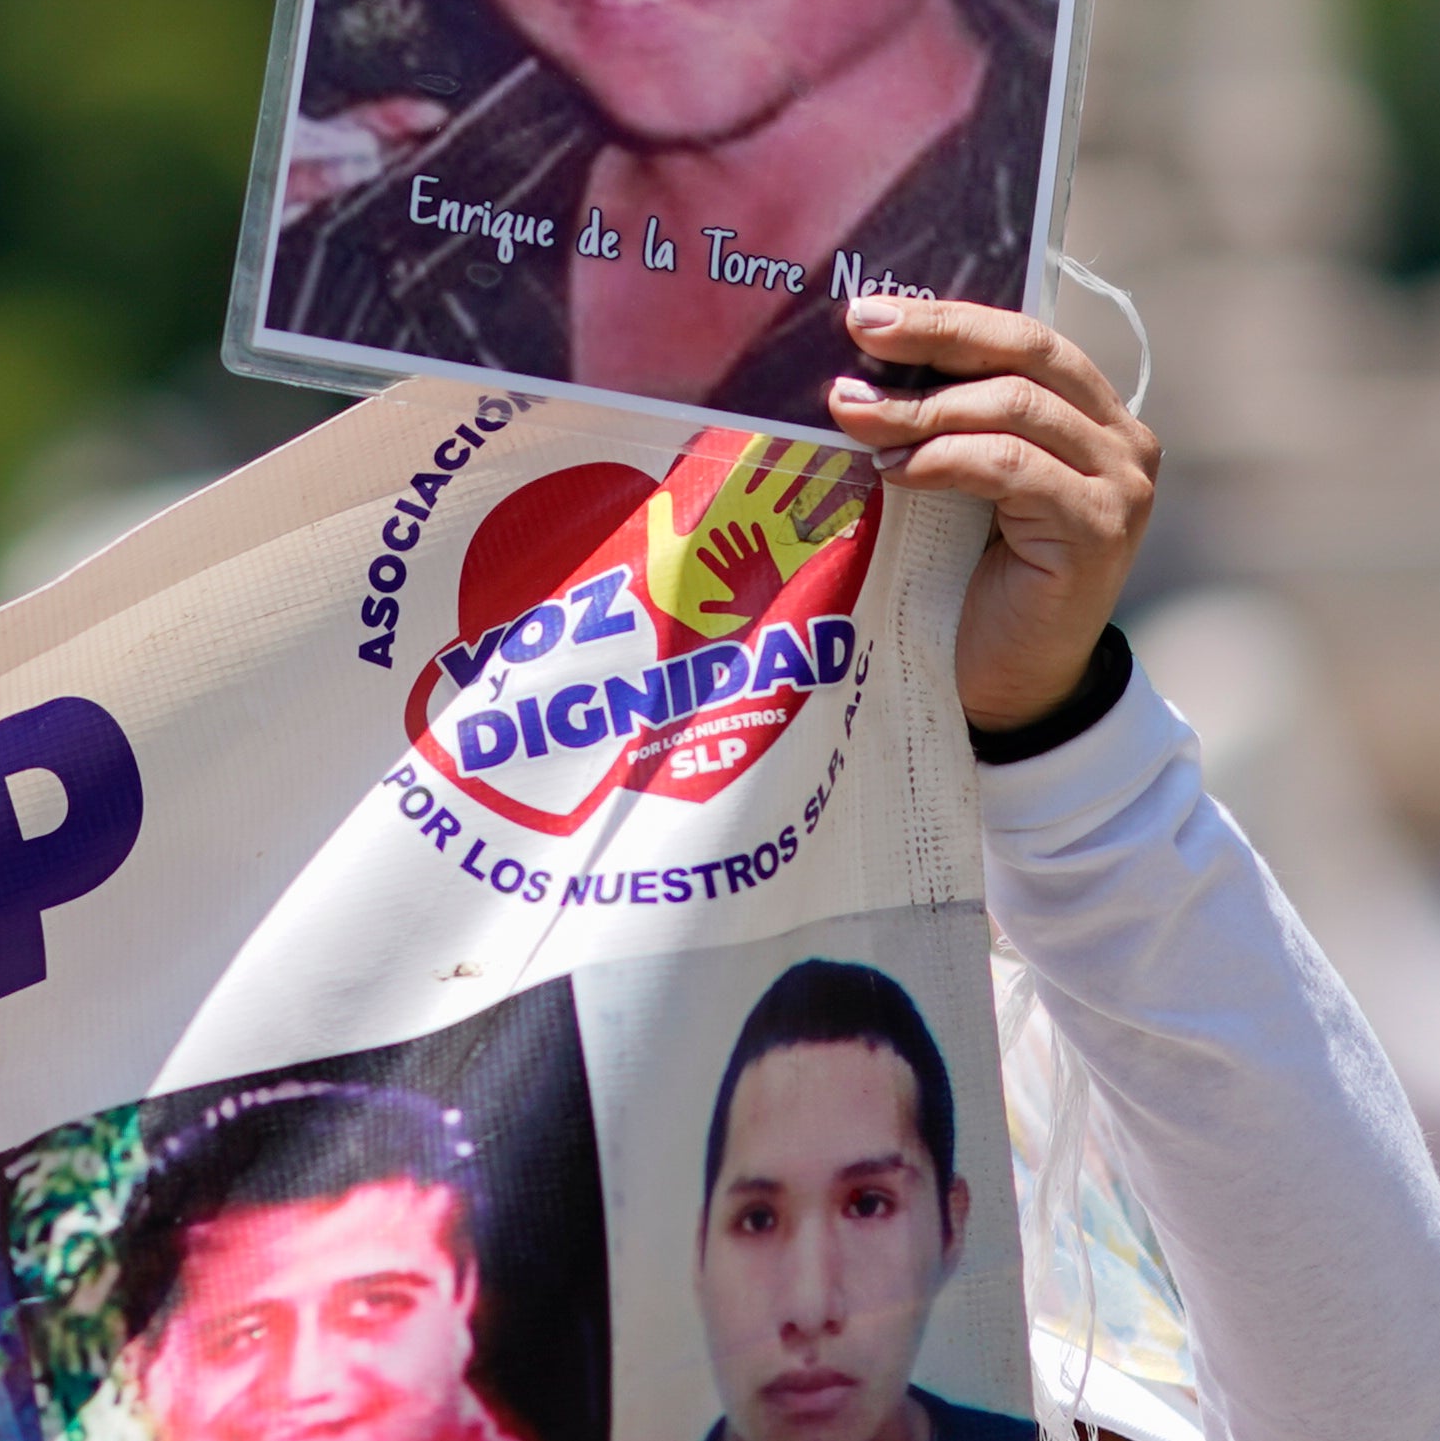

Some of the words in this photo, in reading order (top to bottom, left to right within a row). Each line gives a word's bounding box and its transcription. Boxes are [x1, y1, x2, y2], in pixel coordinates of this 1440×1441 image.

[409, 174, 555, 264] Enrique
[577, 208, 620, 259] de
[644, 216, 676, 271] la
[702, 228, 805, 293] Torre
[439, 569, 637, 690] VOZ
[489, 668, 511, 702] y
[456, 620, 856, 772] DIGNIDAD
[626, 744, 662, 766] POR
[663, 728, 695, 750] LOS
[695, 708, 788, 738] NUESTROS
[669, 737, 747, 780] SLP
[382, 762, 462, 854] POR
[459, 838, 553, 904] LOS
[559, 824, 799, 907] NUESTROS
